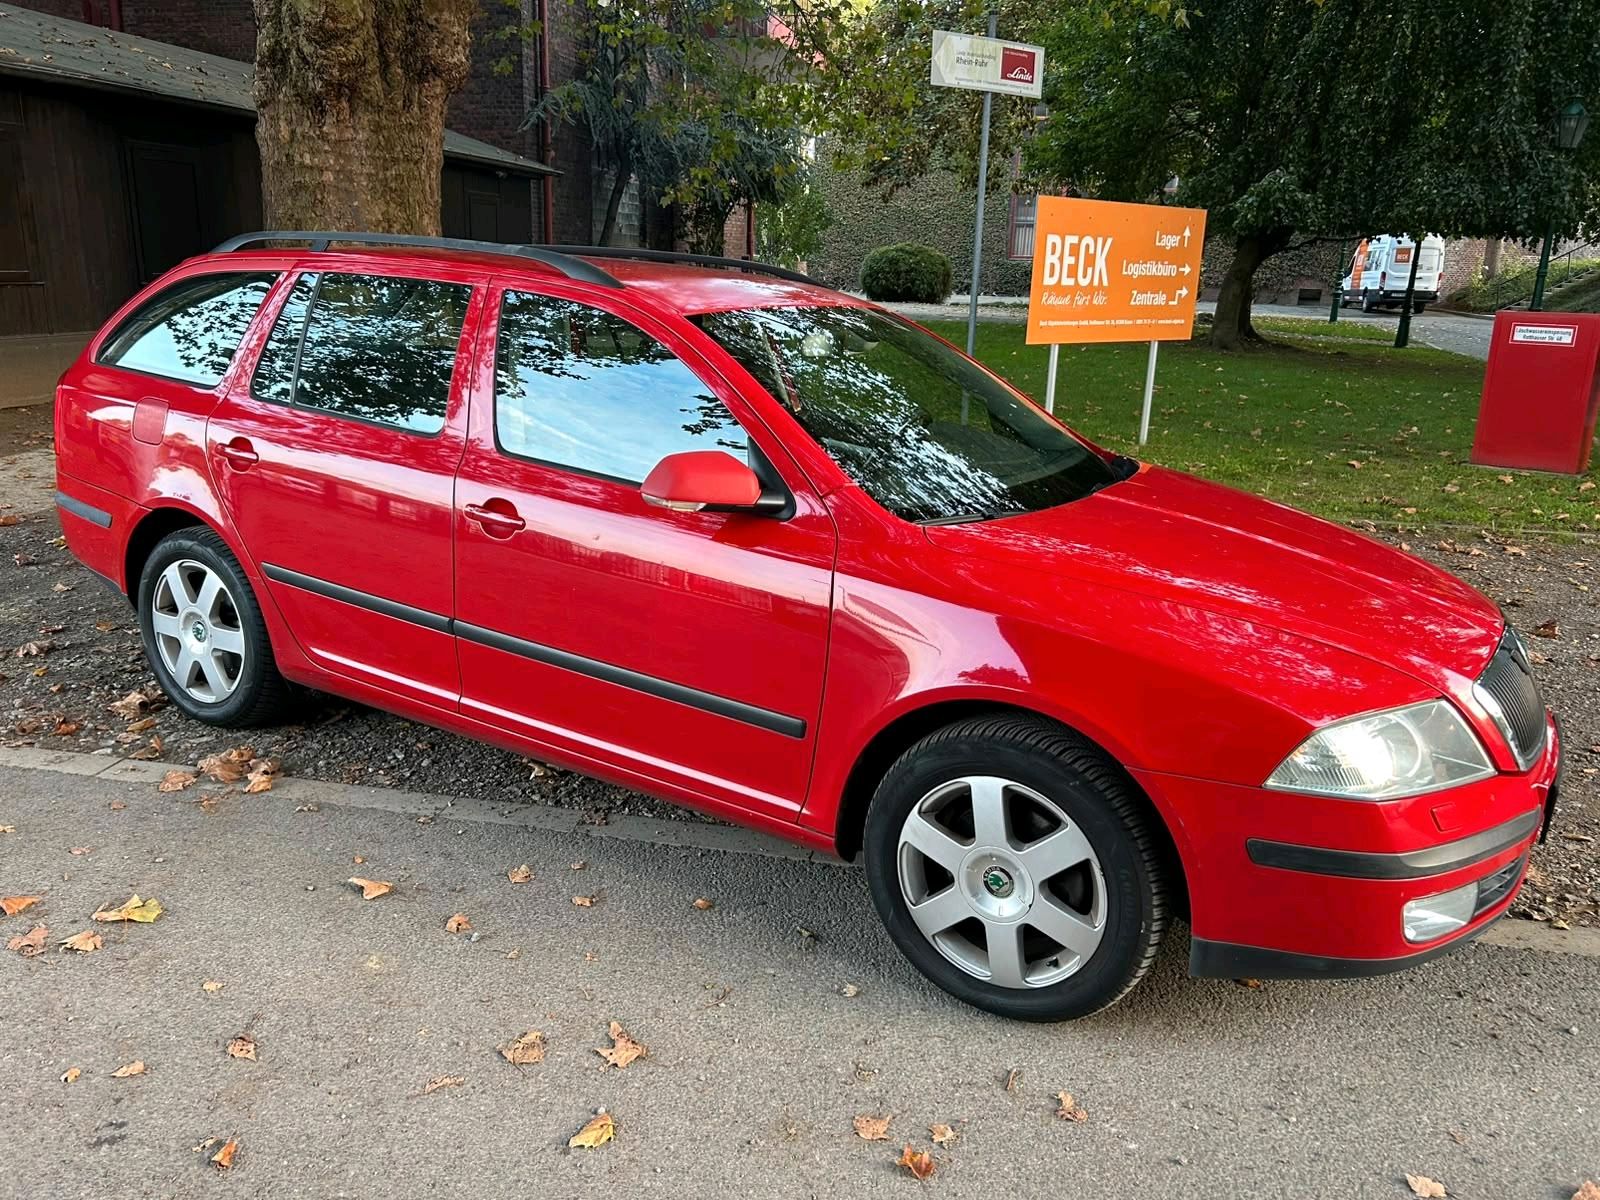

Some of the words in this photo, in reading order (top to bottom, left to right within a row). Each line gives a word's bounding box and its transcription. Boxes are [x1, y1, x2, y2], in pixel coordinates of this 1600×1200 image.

[1006, 67, 1033, 82] Linde
[1155, 230, 1181, 250] Lager
[1042, 233, 1114, 287] BECK
[1122, 259, 1177, 279] Logistikbüro
[1041, 290, 1071, 306] Räume
[1072, 290, 1091, 308] fürs
[1130, 290, 1167, 306] Zentrale
